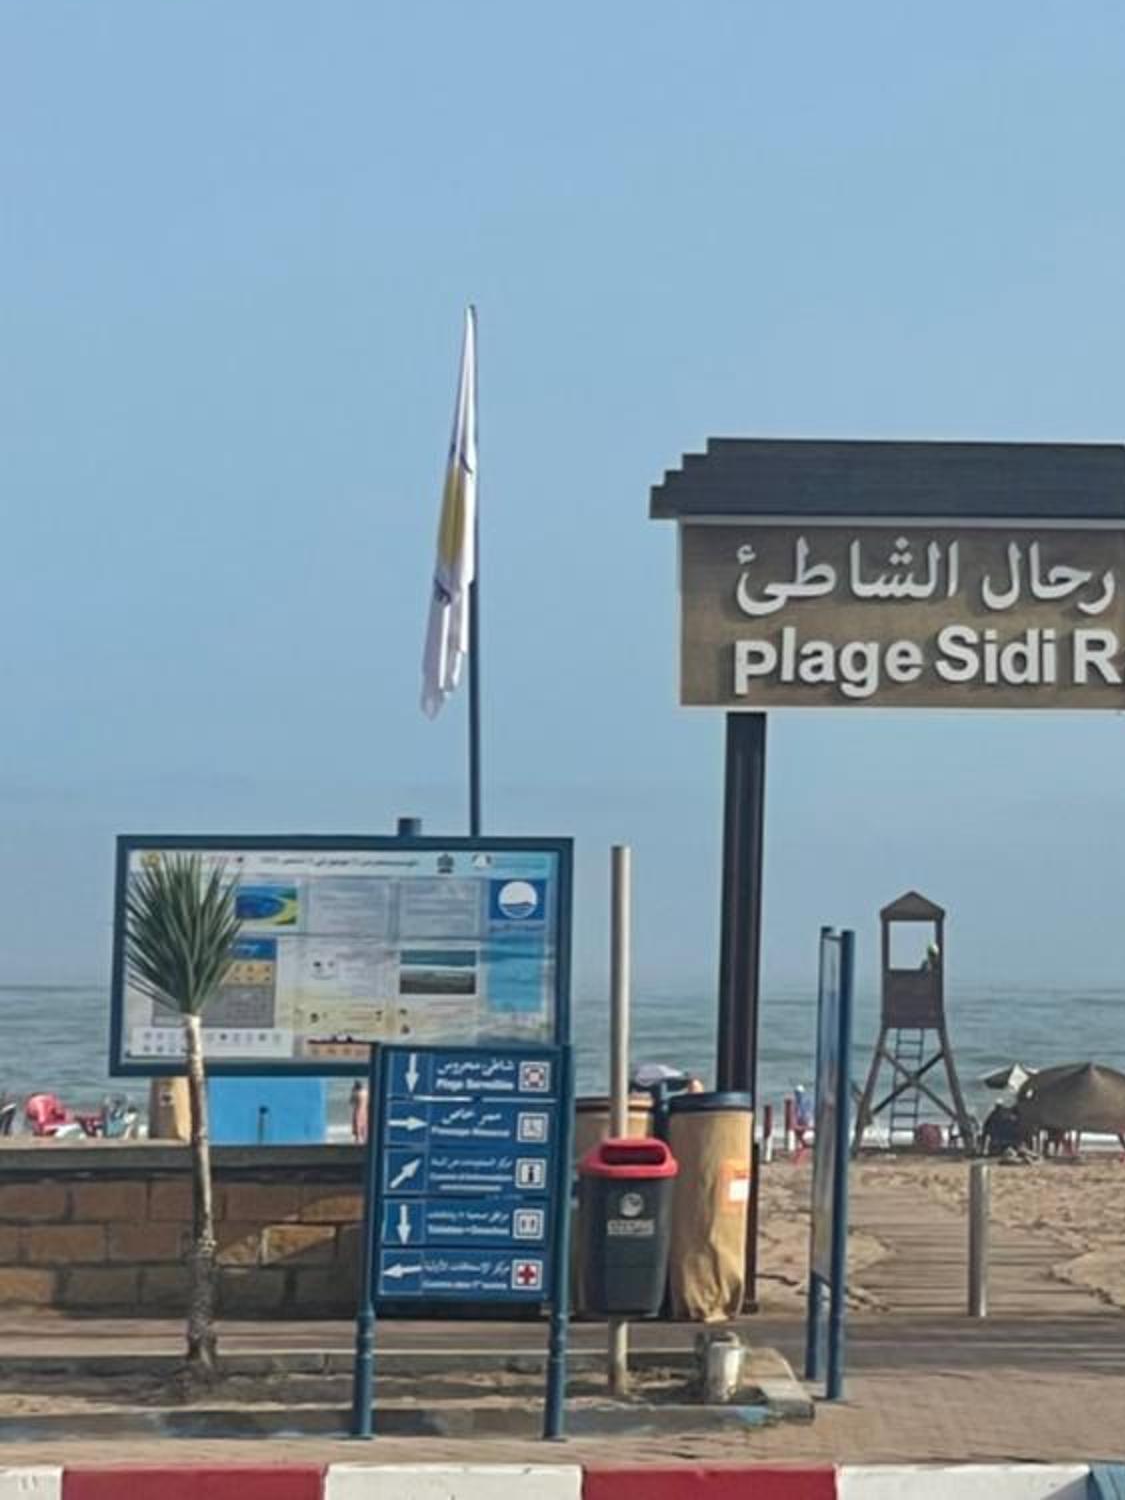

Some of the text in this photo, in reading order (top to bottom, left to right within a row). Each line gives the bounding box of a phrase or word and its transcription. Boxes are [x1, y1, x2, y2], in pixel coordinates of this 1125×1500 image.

[736, 536, 960, 617] الشاطئ
[981, 541, 1116, 615] رحال
[935, 624, 1057, 684] Sidi
